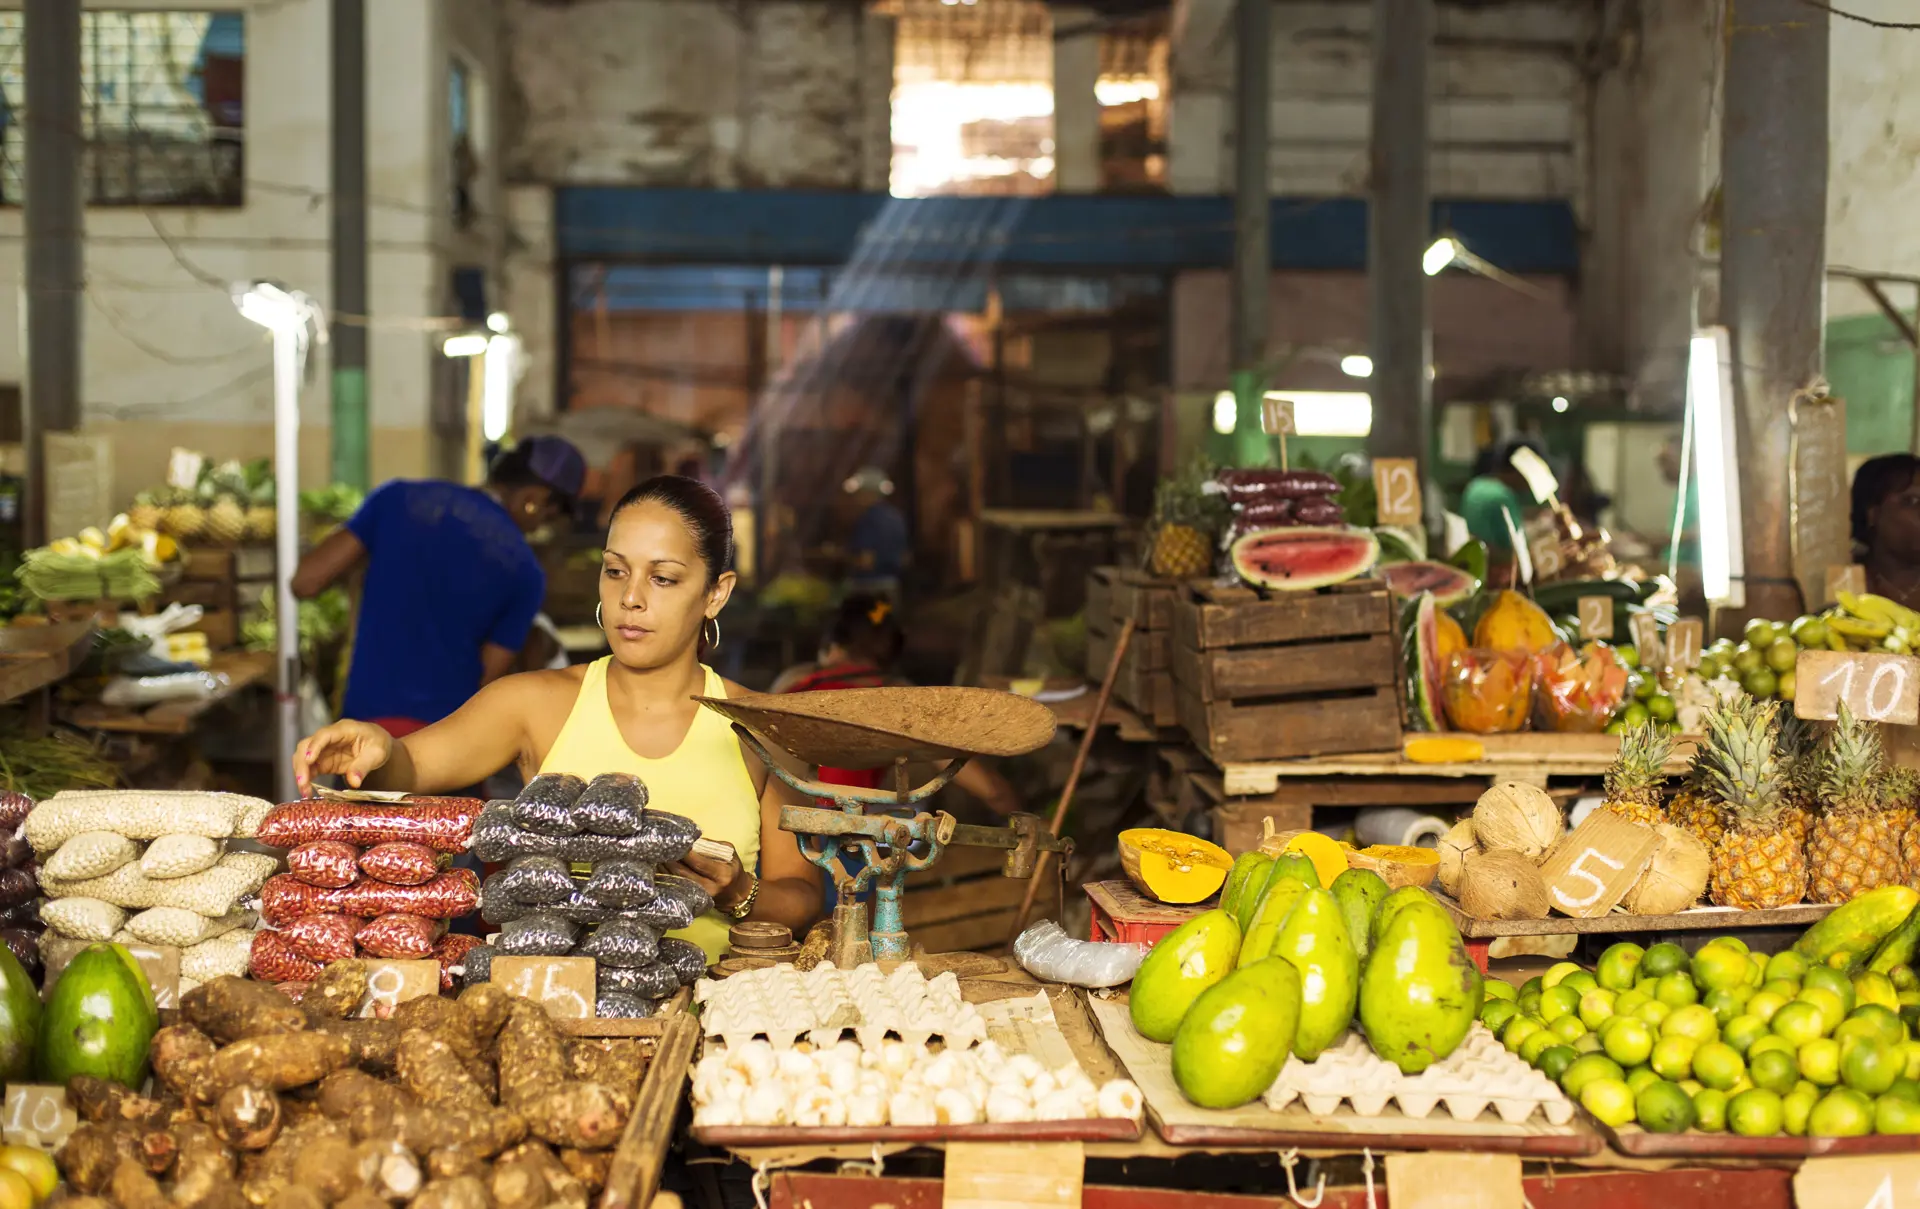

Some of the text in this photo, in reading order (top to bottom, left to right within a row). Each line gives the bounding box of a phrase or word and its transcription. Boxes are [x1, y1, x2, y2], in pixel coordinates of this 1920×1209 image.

[1270, 402, 1293, 432] 15
[1382, 467, 1413, 514] 12
[1587, 601, 1609, 635] 2
[1820, 659, 1907, 720] 10
[1551, 848, 1625, 908] 5
[4, 1089, 62, 1133] 10
